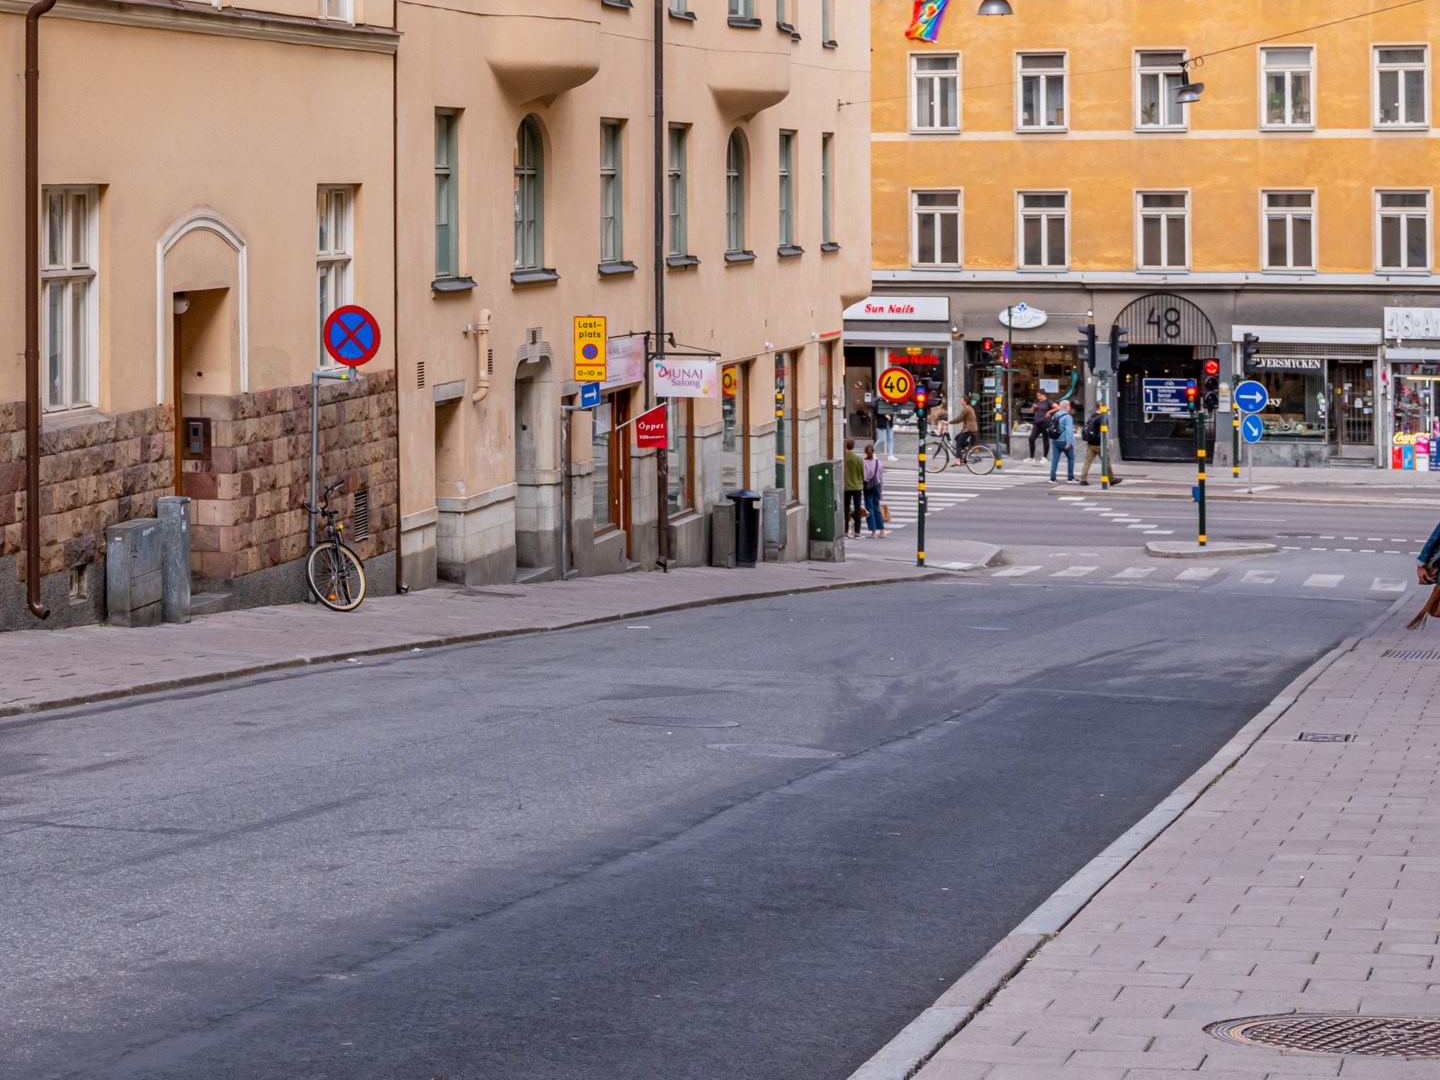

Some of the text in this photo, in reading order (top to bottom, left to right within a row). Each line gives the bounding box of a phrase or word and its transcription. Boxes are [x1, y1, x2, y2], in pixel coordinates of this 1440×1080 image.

[864, 303, 914, 313] Sun Nails
[1147, 307, 1180, 338] 48
[579, 331, 601, 339] plats
[888, 352, 938, 365] Sun Nails
[671, 378, 700, 389] Salong
[883, 376, 908, 393] 40
[638, 421, 664, 431] Öppet
